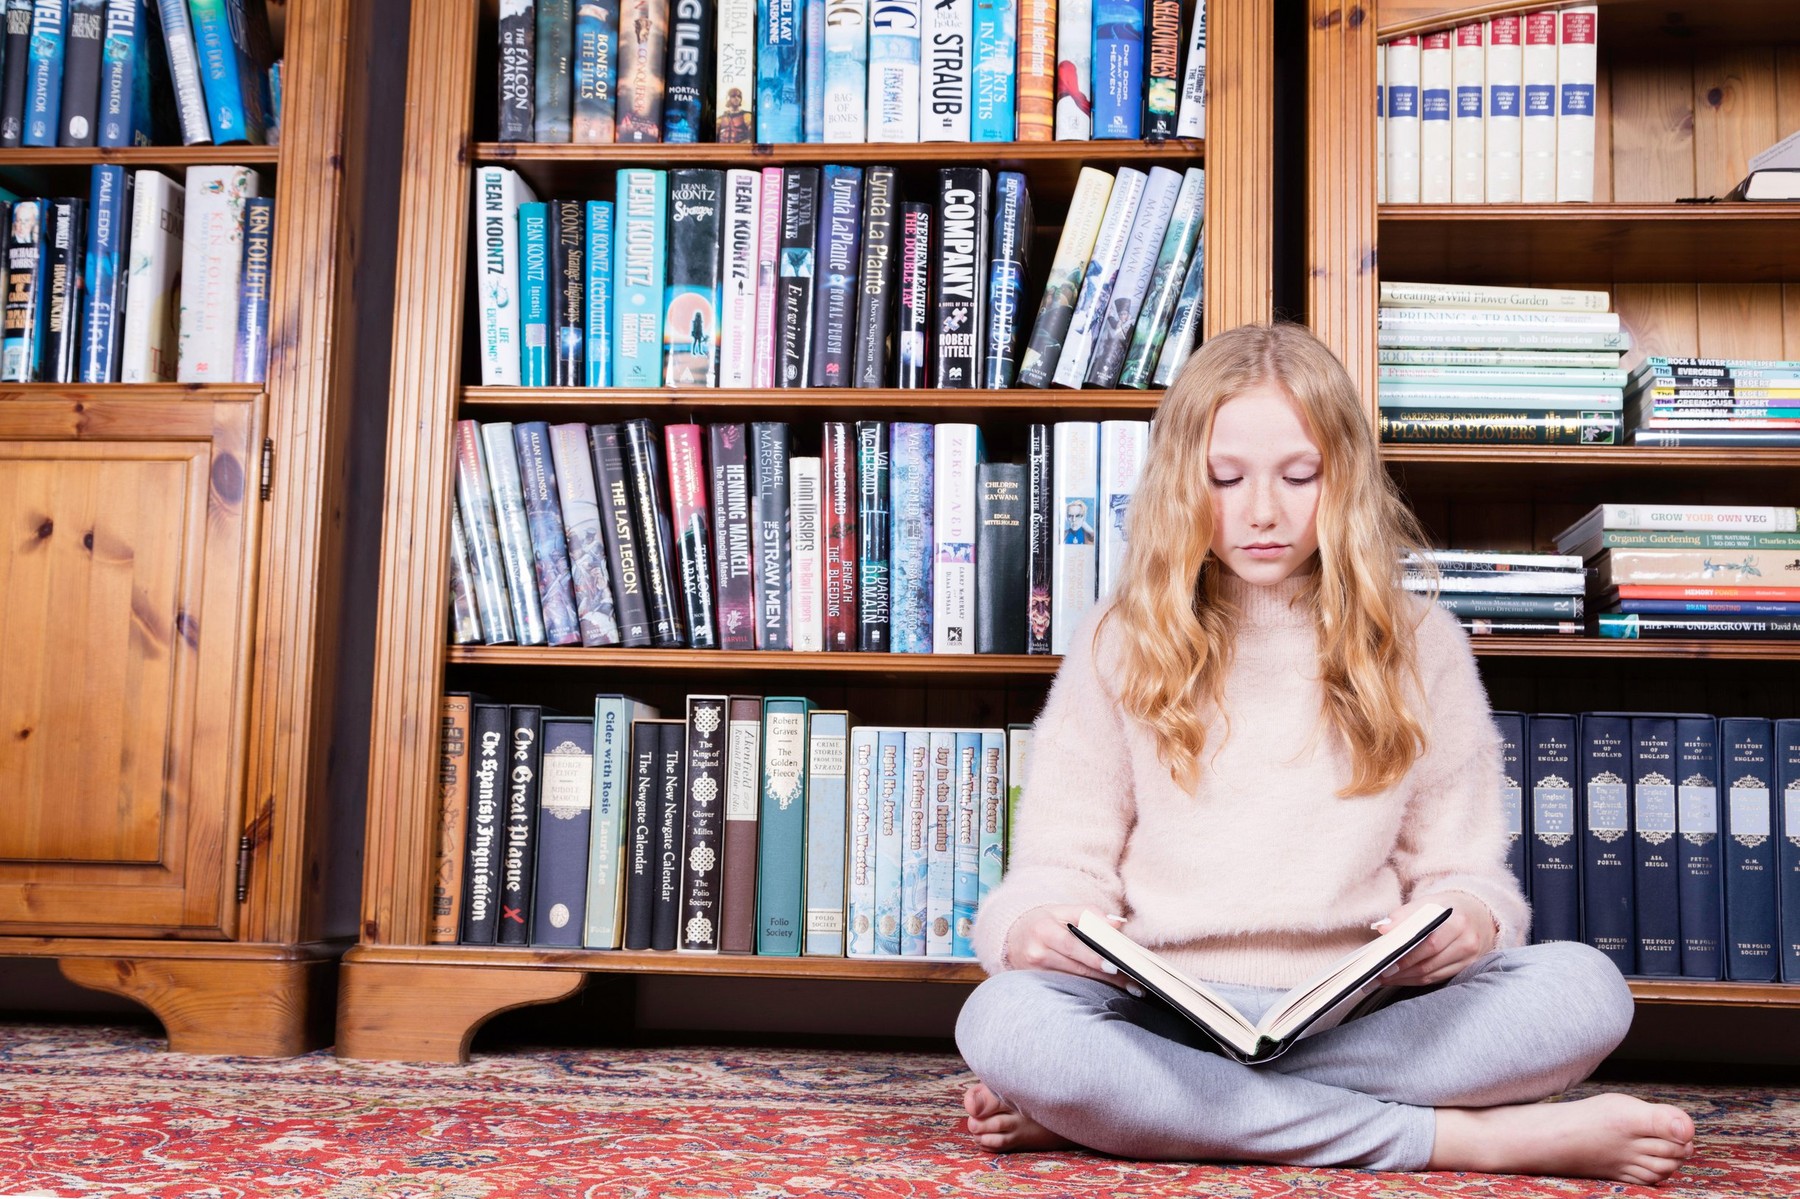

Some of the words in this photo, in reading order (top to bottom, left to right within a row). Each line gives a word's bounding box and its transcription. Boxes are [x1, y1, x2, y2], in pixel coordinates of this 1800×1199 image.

[516, 28, 526, 45] THE
[582, 31, 594, 58] THE
[674, 0, 702, 76] GILES
[1150, 1, 1179, 80] SHADOWFIRES
[596, 34, 609, 78] BONES
[722, 43, 734, 84] KANE
[735, 48, 746, 77] BEN
[35, 59, 48, 112] PREDATOR
[109, 61, 122, 114] PREDATOR
[503, 47, 514, 101] SPARTA
[514, 47, 528, 110] FALCON
[581, 61, 594, 99] HILLS
[596, 81, 607, 100] OF
[668, 86, 699, 96] MORTAL
[932, 34, 964, 115] STRAUB
[673, 93, 693, 102] FEAR
[882, 67, 905, 124] INSOMNIA
[1186, 83, 1194, 100] YEAR
[100, 172, 113, 205] PAUL
[485, 173, 503, 211] DEAN
[628, 172, 656, 219] DEAN
[672, 190, 716, 201] KOONTZ
[734, 175, 752, 215] DEAN
[764, 173, 780, 206] DEAN
[869, 171, 893, 217] Lynda
[97, 209, 111, 247] EDDY
[210, 210, 225, 246] KEN
[248, 205, 270, 235] KEN
[526, 217, 543, 241] DEAN
[561, 203, 579, 246] KOONTZ
[592, 205, 609, 232] DEAN
[762, 208, 779, 257] KOONTZ
[868, 220, 890, 239] La
[905, 211, 917, 235] THE
[486, 217, 505, 275] KOONTZ
[591, 233, 608, 272] KOONTZ
[625, 220, 655, 287] KOONTZ
[731, 219, 752, 279] KOONTZ
[915, 212, 928, 265] STEPHEN
[942, 188, 976, 299] COMPANY
[246, 237, 268, 301] FOLLETT
[527, 243, 543, 282] KOONTZ
[865, 244, 888, 295] Plante
[903, 237, 917, 282] DOUBLE
[205, 256, 221, 332] FOLLETT
[902, 286, 915, 309] TAP
[915, 269, 927, 324] LEATHER
[996, 264, 1017, 300] EVIL
[1390, 290, 1437, 303] Creating
[1438, 294, 1445, 302] a
[1446, 290, 1471, 303] Wild
[1474, 293, 1508, 305] Flower
[1510, 293, 1549, 306] Garden
[828, 287, 844, 319] ROYAL
[869, 297, 880, 323] Above
[87, 302, 110, 354] flint
[499, 327, 509, 344] LIFE
[639, 313, 656, 343] FALSE
[785, 284, 803, 360] Entwined
[827, 322, 843, 354] FLUSH
[992, 302, 1014, 353] DEEDS
[867, 323, 878, 362] Suspicion
[1519, 335, 1539, 344] bob
[1540, 335, 1593, 344] flowerdew
[1677, 368, 1725, 377] EVERGREEN
[1732, 369, 1763, 377] EXPERT
[530, 431, 541, 455] ALLAN
[1391, 421, 1450, 439] PLANTS
[1451, 423, 1462, 439] &
[1463, 424, 1537, 440] FLOWERS
[534, 457, 548, 501] MALLINSON
[715, 465, 725, 479] The
[760, 429, 773, 499] MARSHALL
[773, 441, 784, 489] MICHAEL
[611, 481, 624, 506] THE
[716, 481, 726, 505] Return
[726, 464, 747, 520] HENNING
[614, 510, 630, 541] LAST
[718, 507, 727, 515] of
[718, 517, 727, 529] the
[763, 521, 780, 529] THE
[1650, 513, 1683, 522] GROW
[1684, 513, 1714, 522] YOUR
[1717, 514, 1742, 523] OWN
[1744, 515, 1767, 523] VEG
[717, 530, 728, 561] Dancing
[730, 523, 750, 579] MANKELL
[828, 545, 839, 563] THE
[1608, 534, 1647, 545] Organic
[1649, 534, 1701, 545] Gardening
[1759, 537, 1787, 545] Charles
[619, 545, 638, 595] LEGION
[719, 562, 729, 588] Master
[763, 529, 780, 587] STRAW
[878, 565, 889, 573] A
[828, 568, 840, 617] BLEEDING
[842, 560, 852, 603] BENEATH
[861, 564, 877, 624] DOMAIN
[765, 589, 780, 628] MEN
[877, 576, 889, 623] DARKER
[1770, 622, 1792, 631] David
[604, 711, 616, 745] Cider
[772, 717, 798, 725] Robert
[772, 727, 798, 735] Graves
[482, 731, 500, 757] The
[513, 728, 534, 760] The
[742, 730, 755, 789] Akenfield
[777, 748, 792, 757] The
[911, 747, 925, 768] The
[934, 747, 950, 766] Joy
[985, 747, 1000, 774] Ring
[603, 748, 614, 778] with
[639, 751, 652, 774] The
[665, 751, 678, 774] The
[770, 759, 798, 767] Golden
[771, 769, 796, 777] Fleece
[936, 768, 949, 780] in
[476, 759, 497, 824] Spanish
[511, 765, 534, 822] Great
[601, 781, 613, 815] Rosie
[635, 776, 651, 824] Newgate
[664, 775, 678, 801] New
[909, 770, 924, 809] Mating
[936, 783, 950, 803] the
[986, 776, 999, 796] for
[661, 802, 677, 850] Newgate
[910, 810, 924, 851] Season
[935, 804, 949, 852] Morning
[985, 797, 1000, 834] Jeeves
[505, 824, 529, 893] Plague
[634, 825, 649, 876] Calendar
[471, 824, 494, 921] Inquisition
[661, 851, 675, 903] Calendar
[689, 899, 712, 908] Society
[692, 889, 710, 897] Folio
[766, 928, 793, 938] Society
[770, 917, 789, 926] Folio
